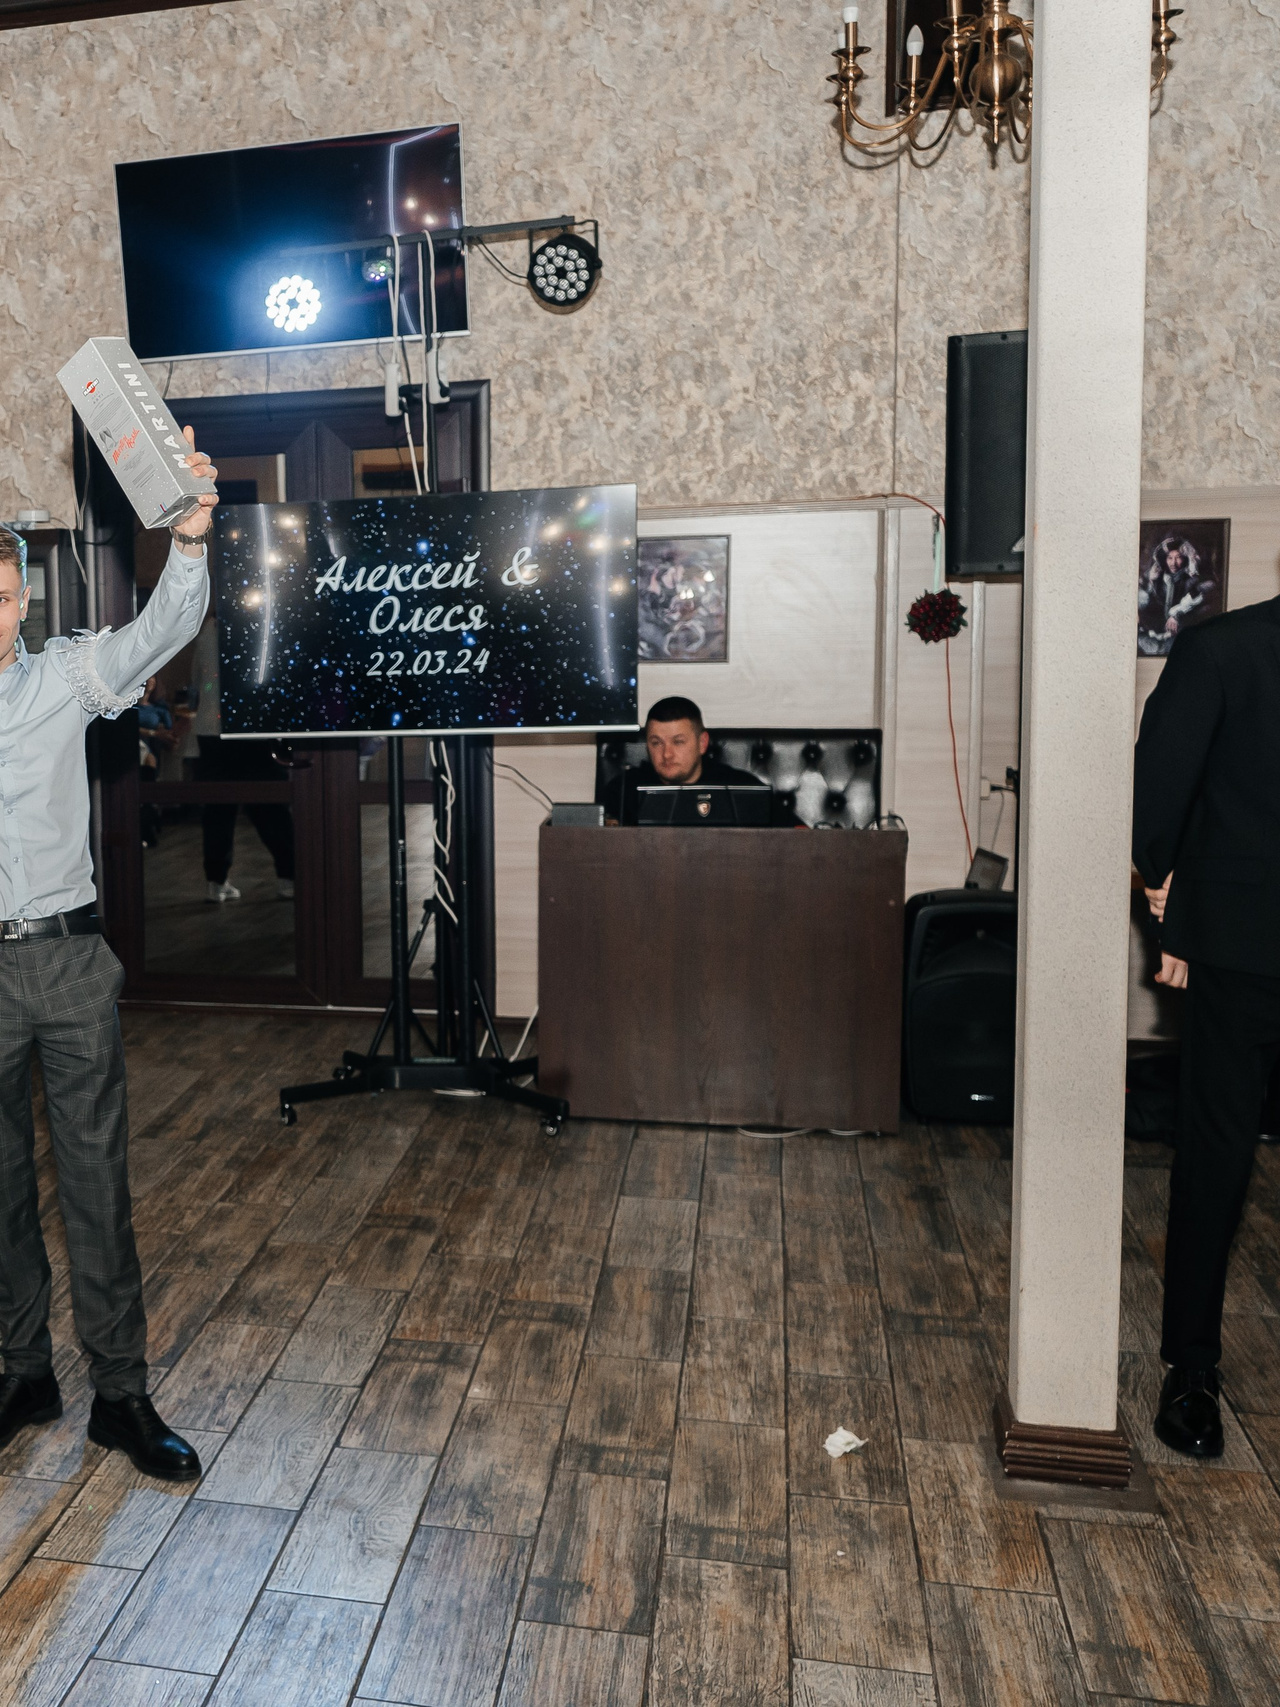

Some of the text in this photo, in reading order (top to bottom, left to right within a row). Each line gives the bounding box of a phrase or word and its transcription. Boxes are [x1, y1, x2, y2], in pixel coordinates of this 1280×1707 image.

[117, 363, 191, 469] MARTINI
[314, 545, 540, 595] Алексей &
[368, 595, 489, 635] Олеся
[366, 648, 491, 677] 22.03.24
